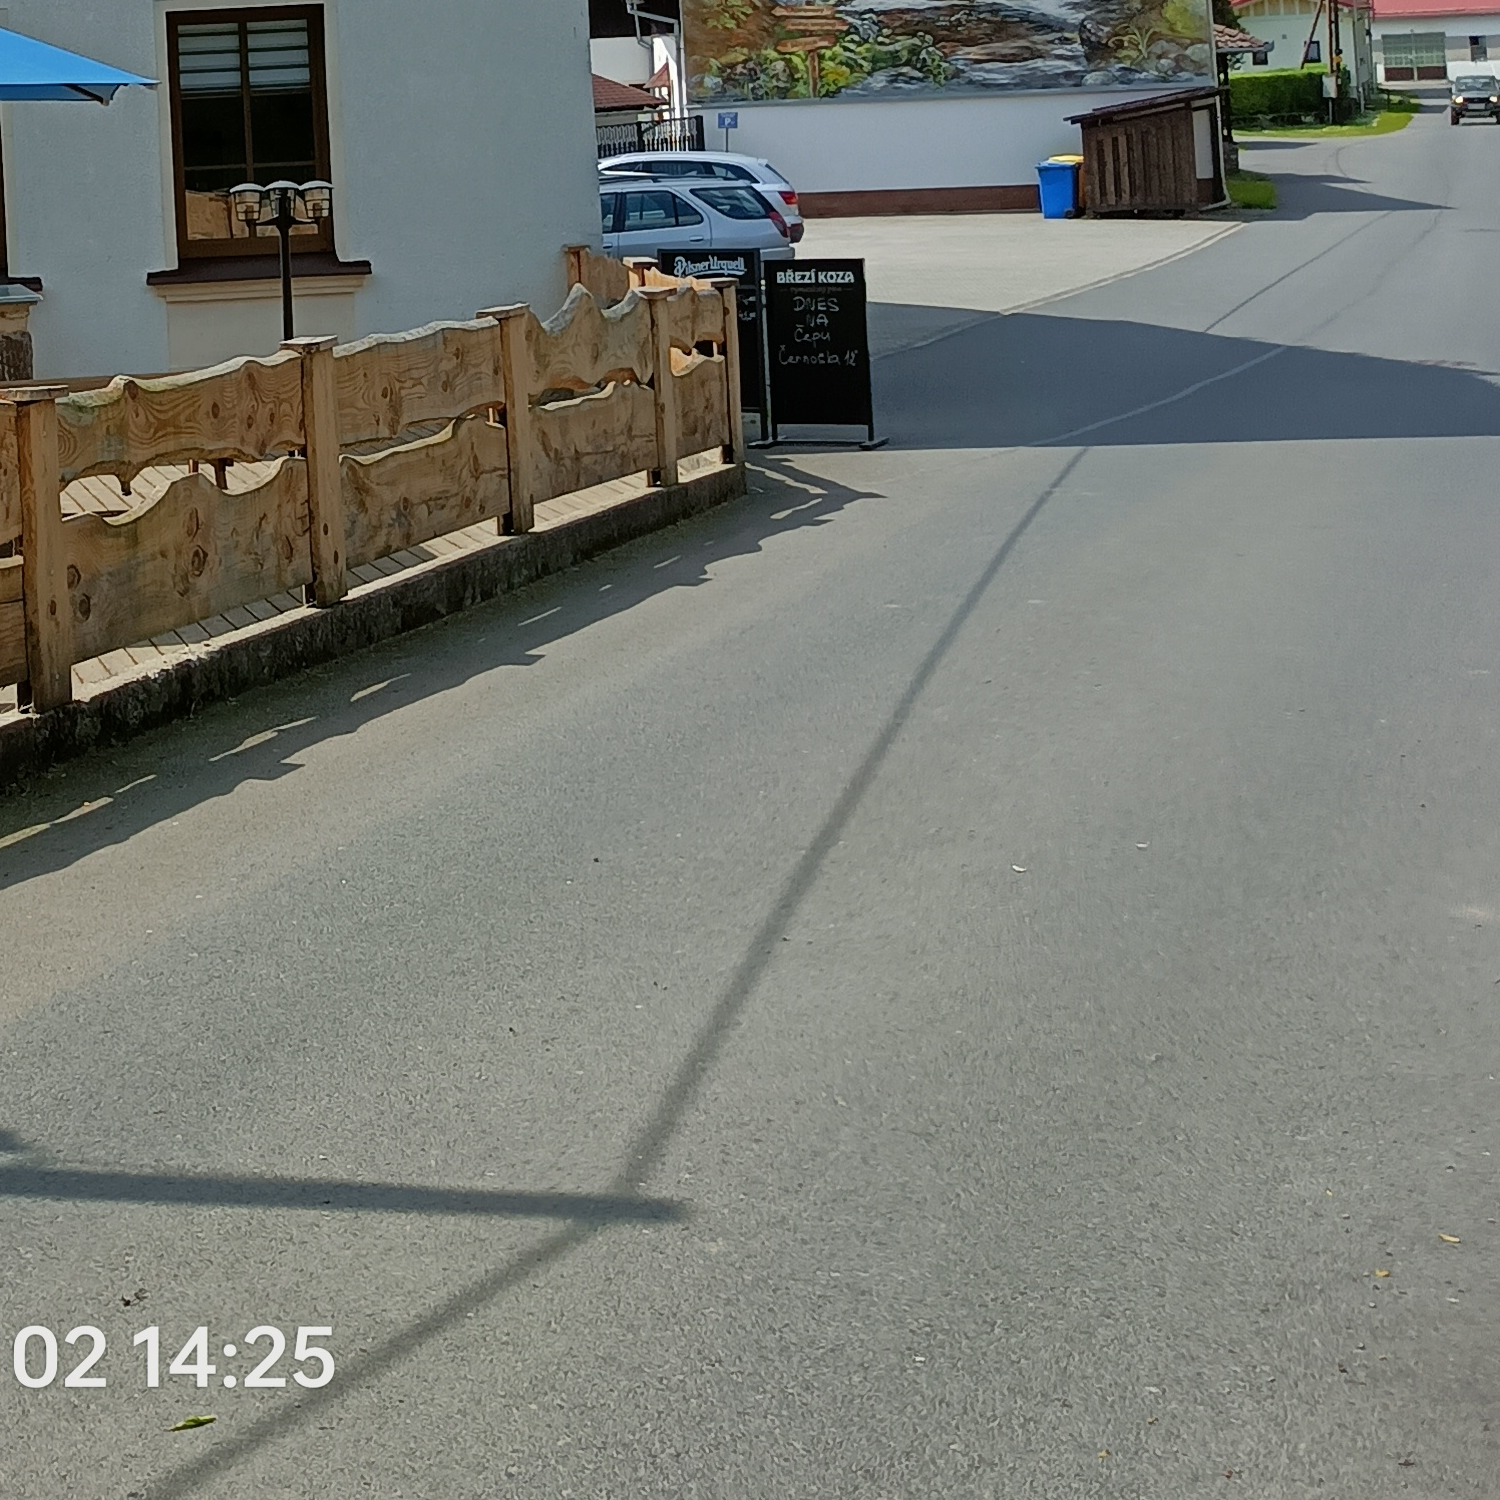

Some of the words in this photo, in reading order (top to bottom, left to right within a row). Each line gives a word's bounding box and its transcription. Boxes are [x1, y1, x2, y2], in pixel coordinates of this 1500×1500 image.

[673, 256, 710, 278] Pilsner
[708, 255, 747, 276] Urquell
[776, 268, 817, 284] BŘEZÍ
[817, 270, 855, 284] KOZA
[793, 296, 840, 312] DNES
[806, 313, 829, 328] NA
